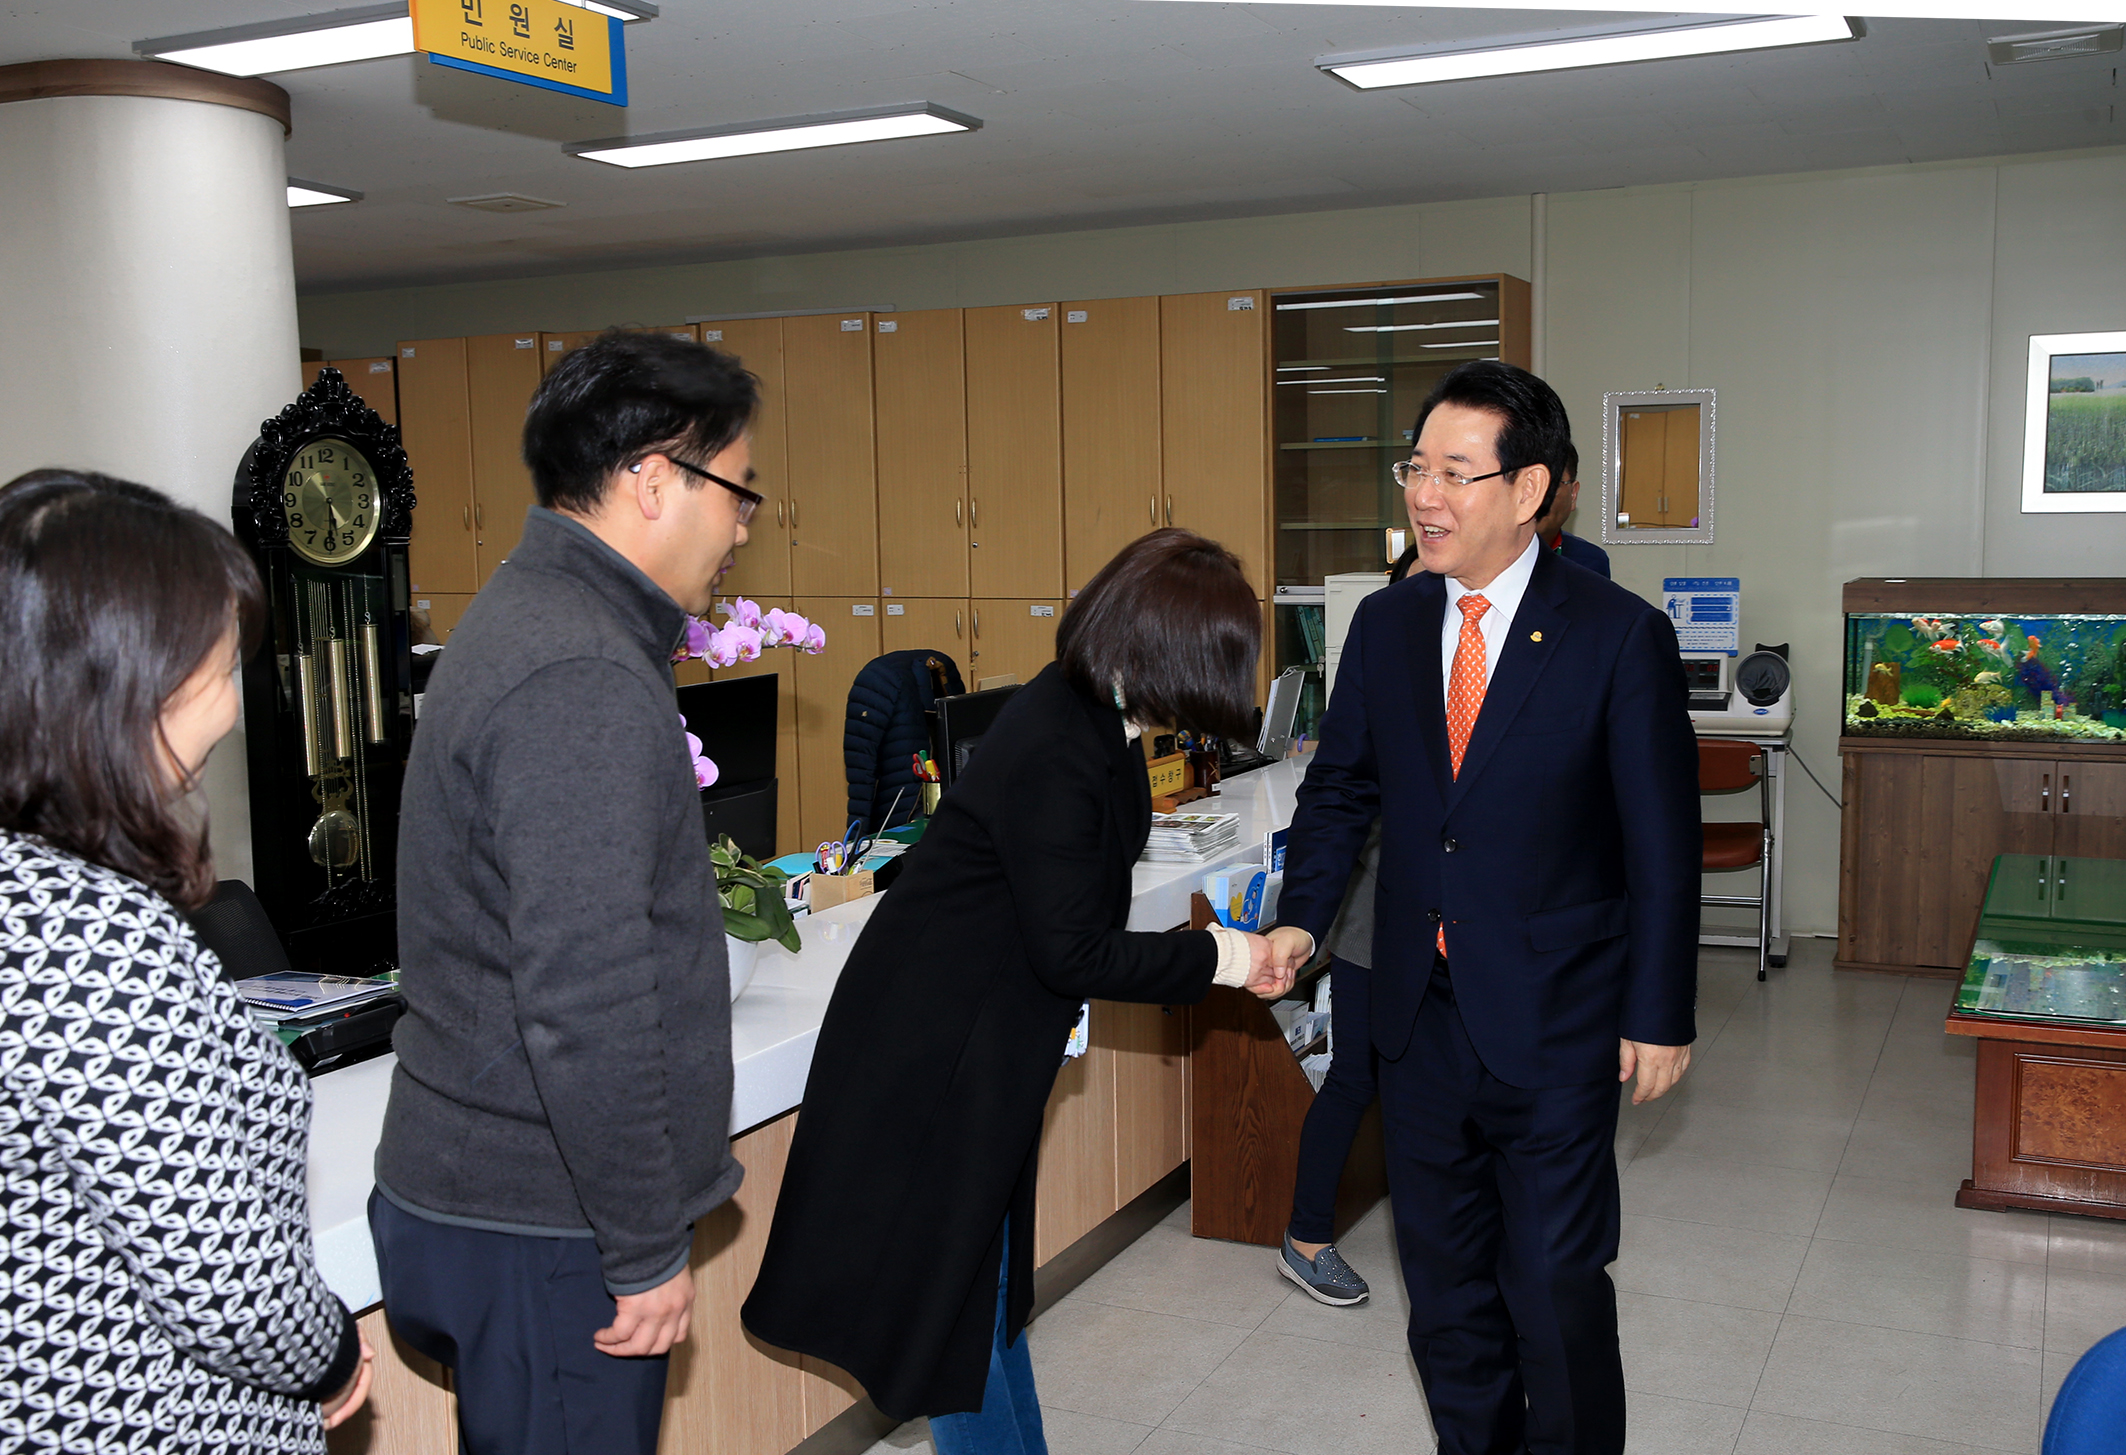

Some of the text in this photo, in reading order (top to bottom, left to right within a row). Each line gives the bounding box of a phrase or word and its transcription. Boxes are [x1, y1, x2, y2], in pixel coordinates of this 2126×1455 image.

[461, 32, 577, 73] Public Service Center
[300, 456, 314, 470] 11
[317, 448, 334, 464] 12
[343, 457, 350, 471] 1
[288, 471, 303, 487] 10
[352, 473, 365, 487] 2
[284, 492, 297, 508] 9
[357, 493, 370, 509] 3
[290, 513, 304, 528] 8
[353, 514, 366, 528] 4
[304, 530, 317, 544] 7
[323, 535, 337, 551] 6
[342, 530, 355, 546] 5
